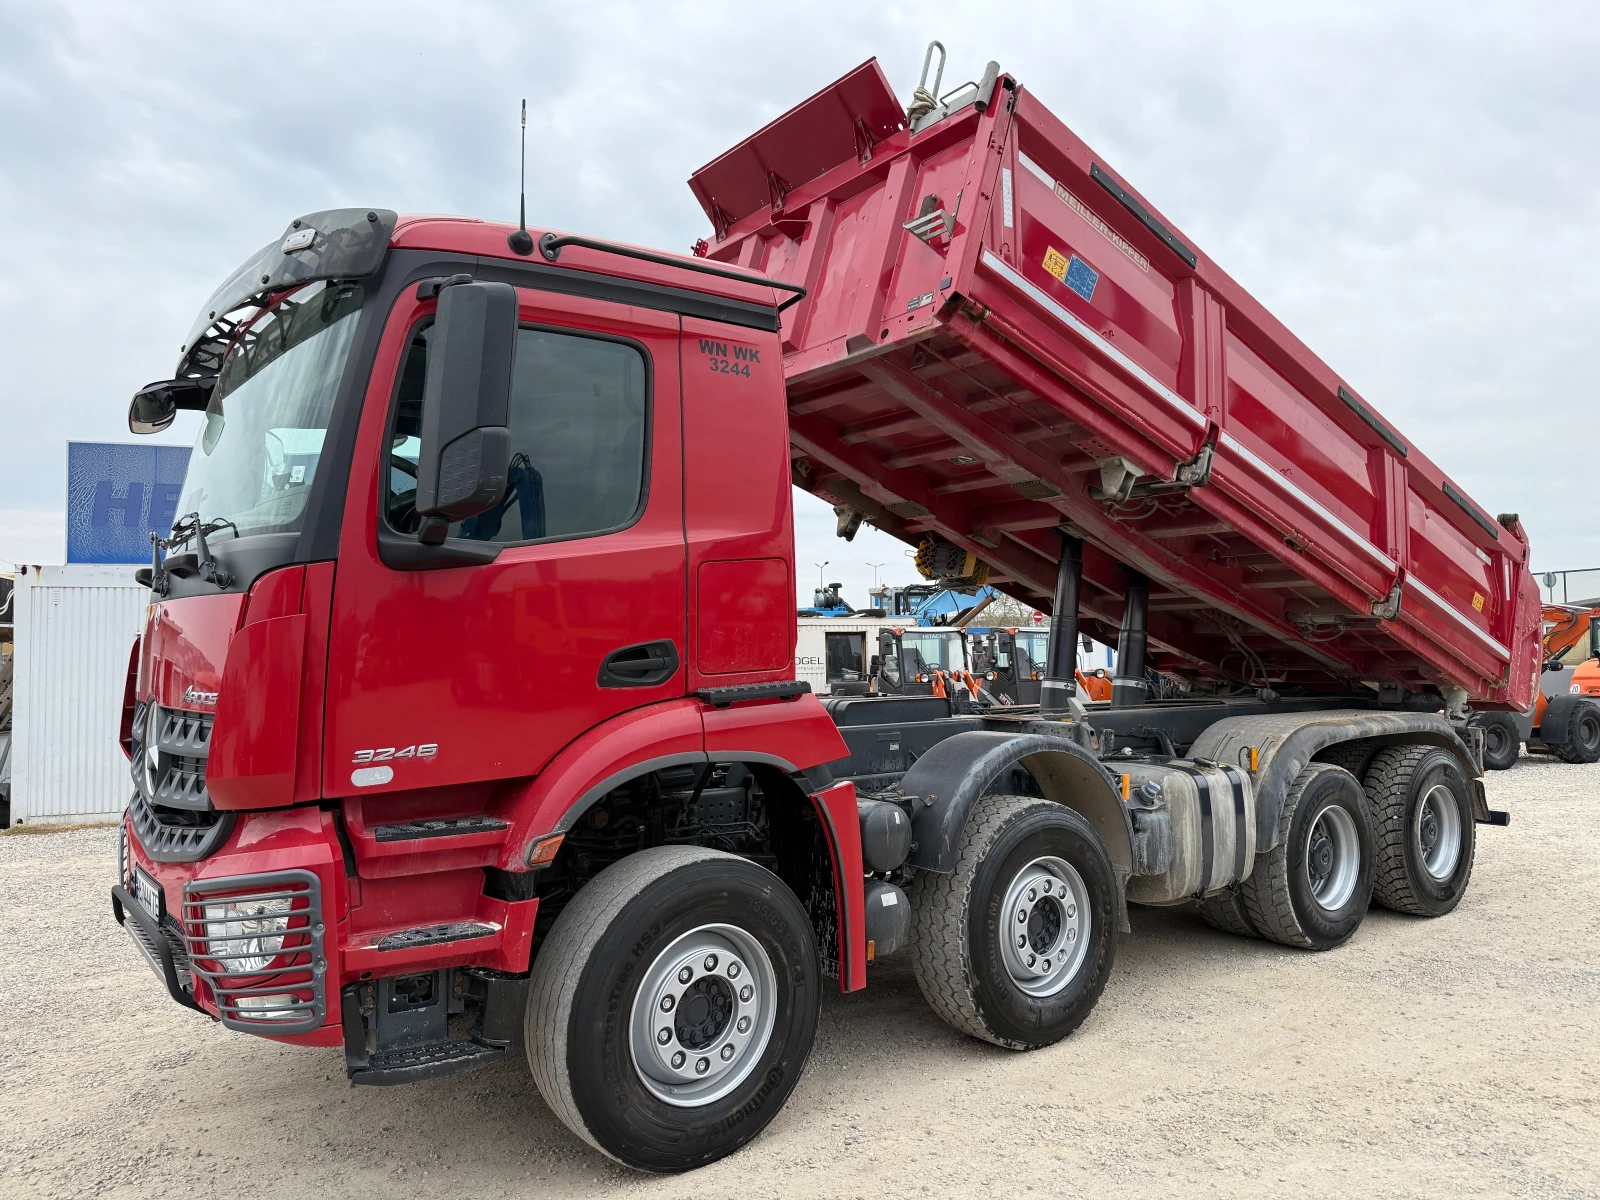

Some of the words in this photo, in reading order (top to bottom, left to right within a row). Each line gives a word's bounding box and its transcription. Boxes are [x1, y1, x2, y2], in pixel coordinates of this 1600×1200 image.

[1058, 185, 1148, 269] MEILLER-KIPPER
[698, 339, 727, 358] WN
[733, 346, 761, 364] WK
[709, 357, 751, 378] 3244
[1571, 685, 1579, 693] 20
[351, 743, 438, 763] 3246
